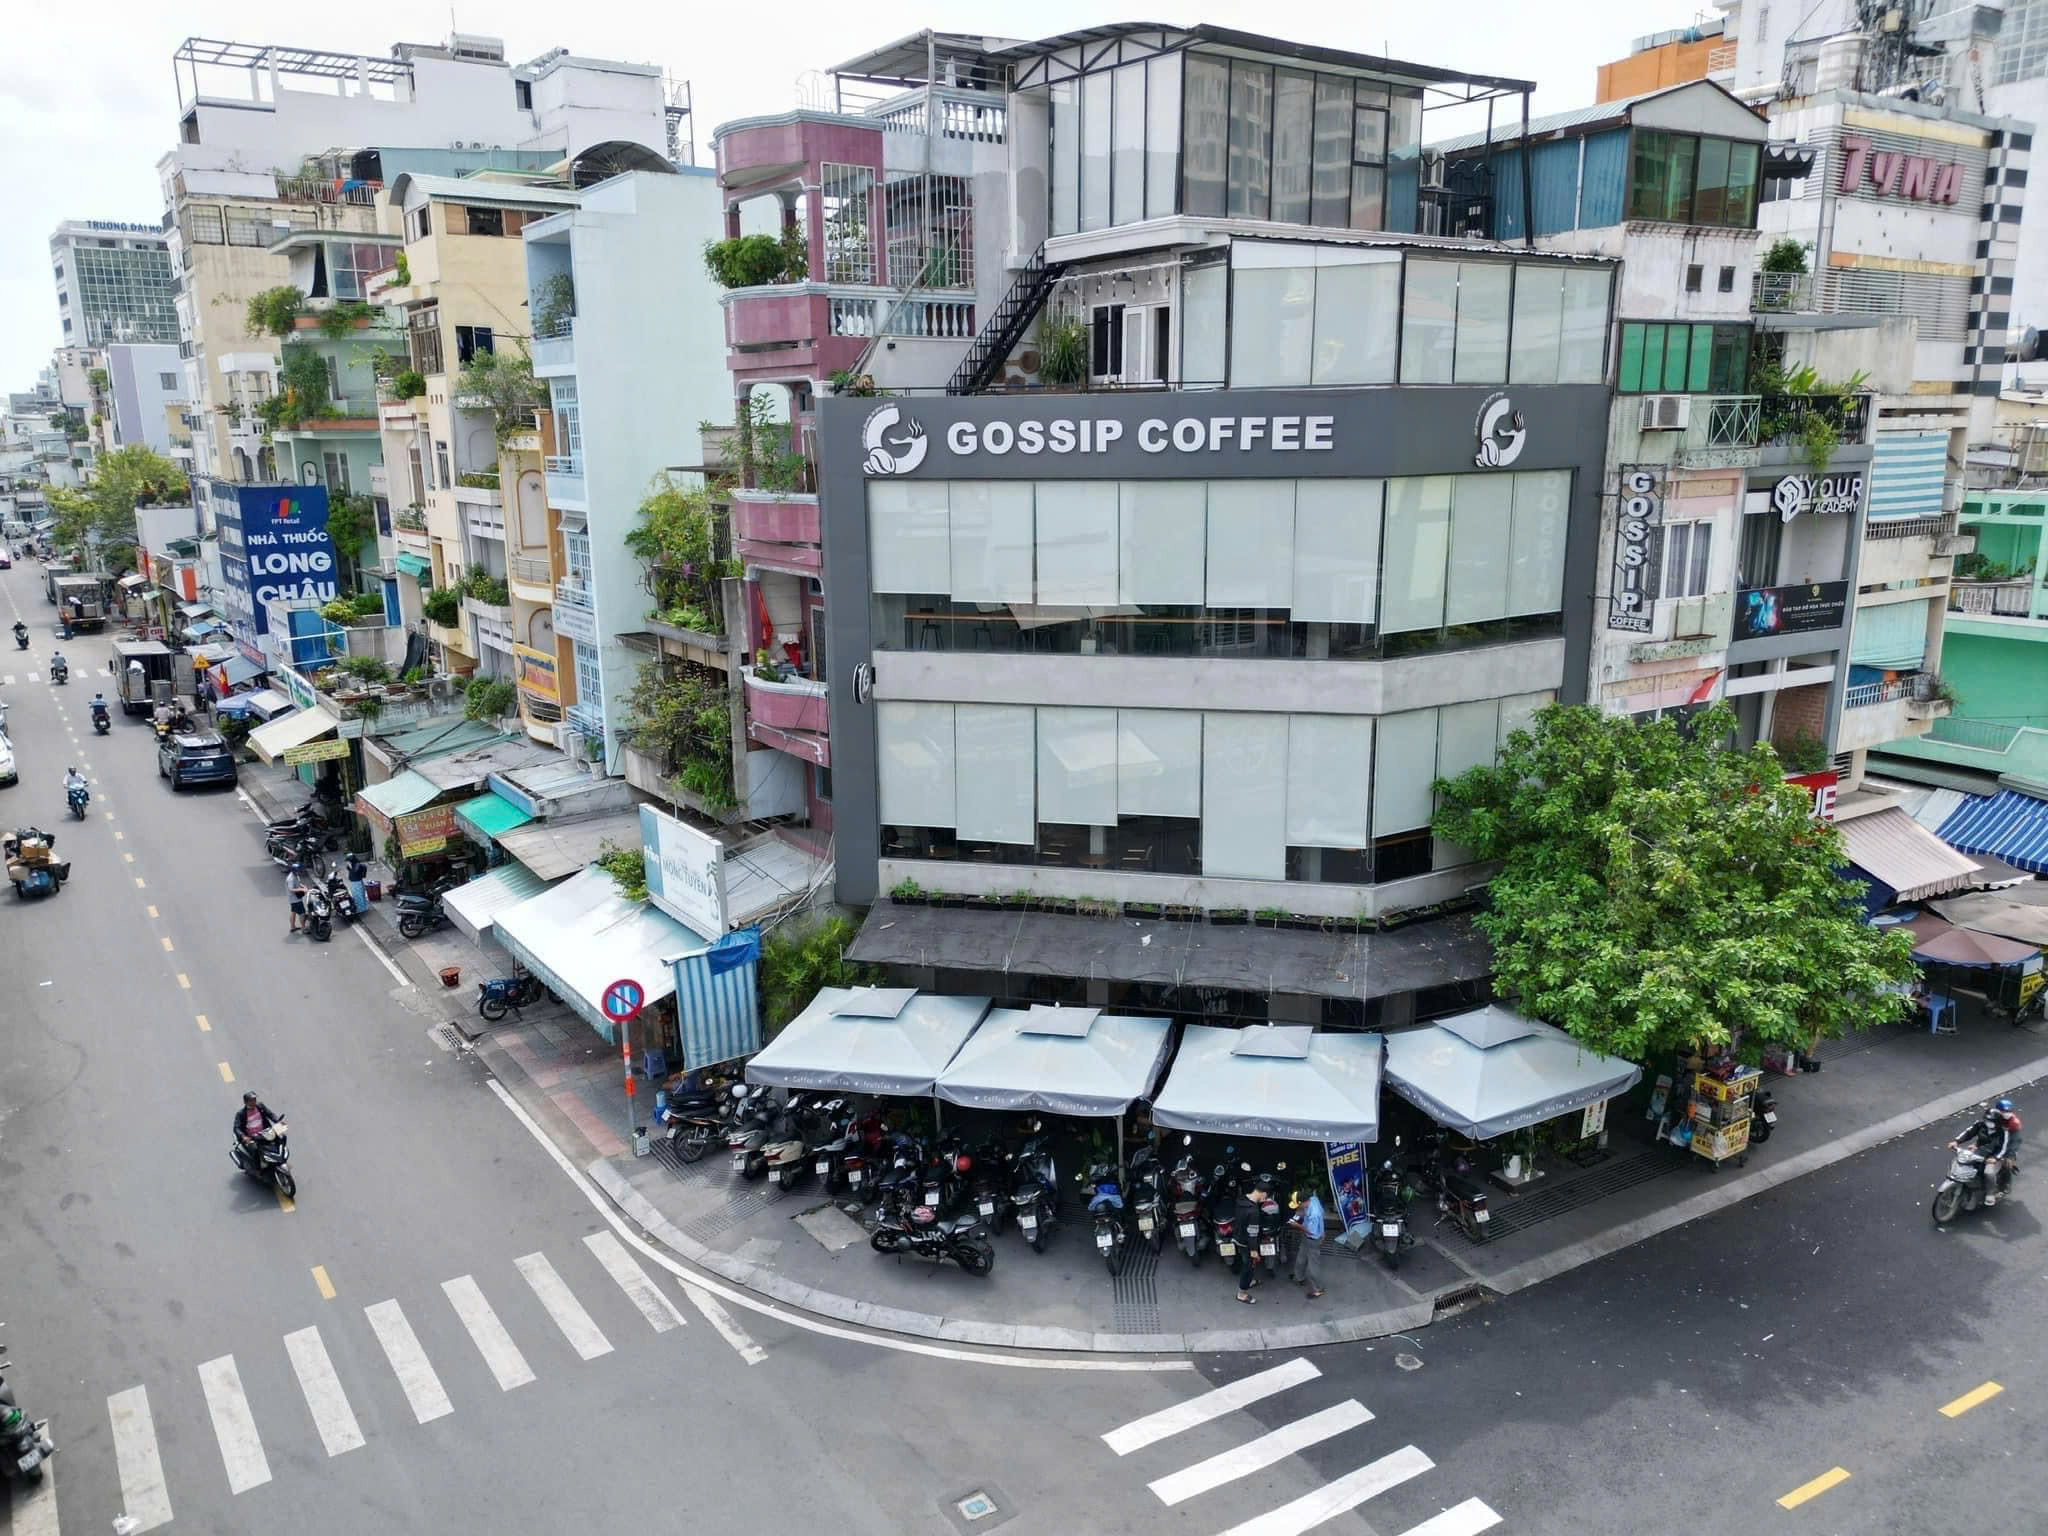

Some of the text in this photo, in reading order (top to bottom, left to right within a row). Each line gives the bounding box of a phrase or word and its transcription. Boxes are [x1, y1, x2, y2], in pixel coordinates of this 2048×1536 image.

[946, 415, 1334, 455] GOSSIP COFFEE
[1805, 478, 1863, 502] YOUR
[1814, 499, 1859, 515] ACADEMY
[247, 527, 328, 545] NHÀ THUỐC
[1620, 472, 1653, 612] GOSSIP
[250, 551, 332, 575] LONG
[256, 577, 336, 606] CHÂU
[1609, 616, 1648, 629] COFFEE
[1328, 1150, 1360, 1168] FREE
